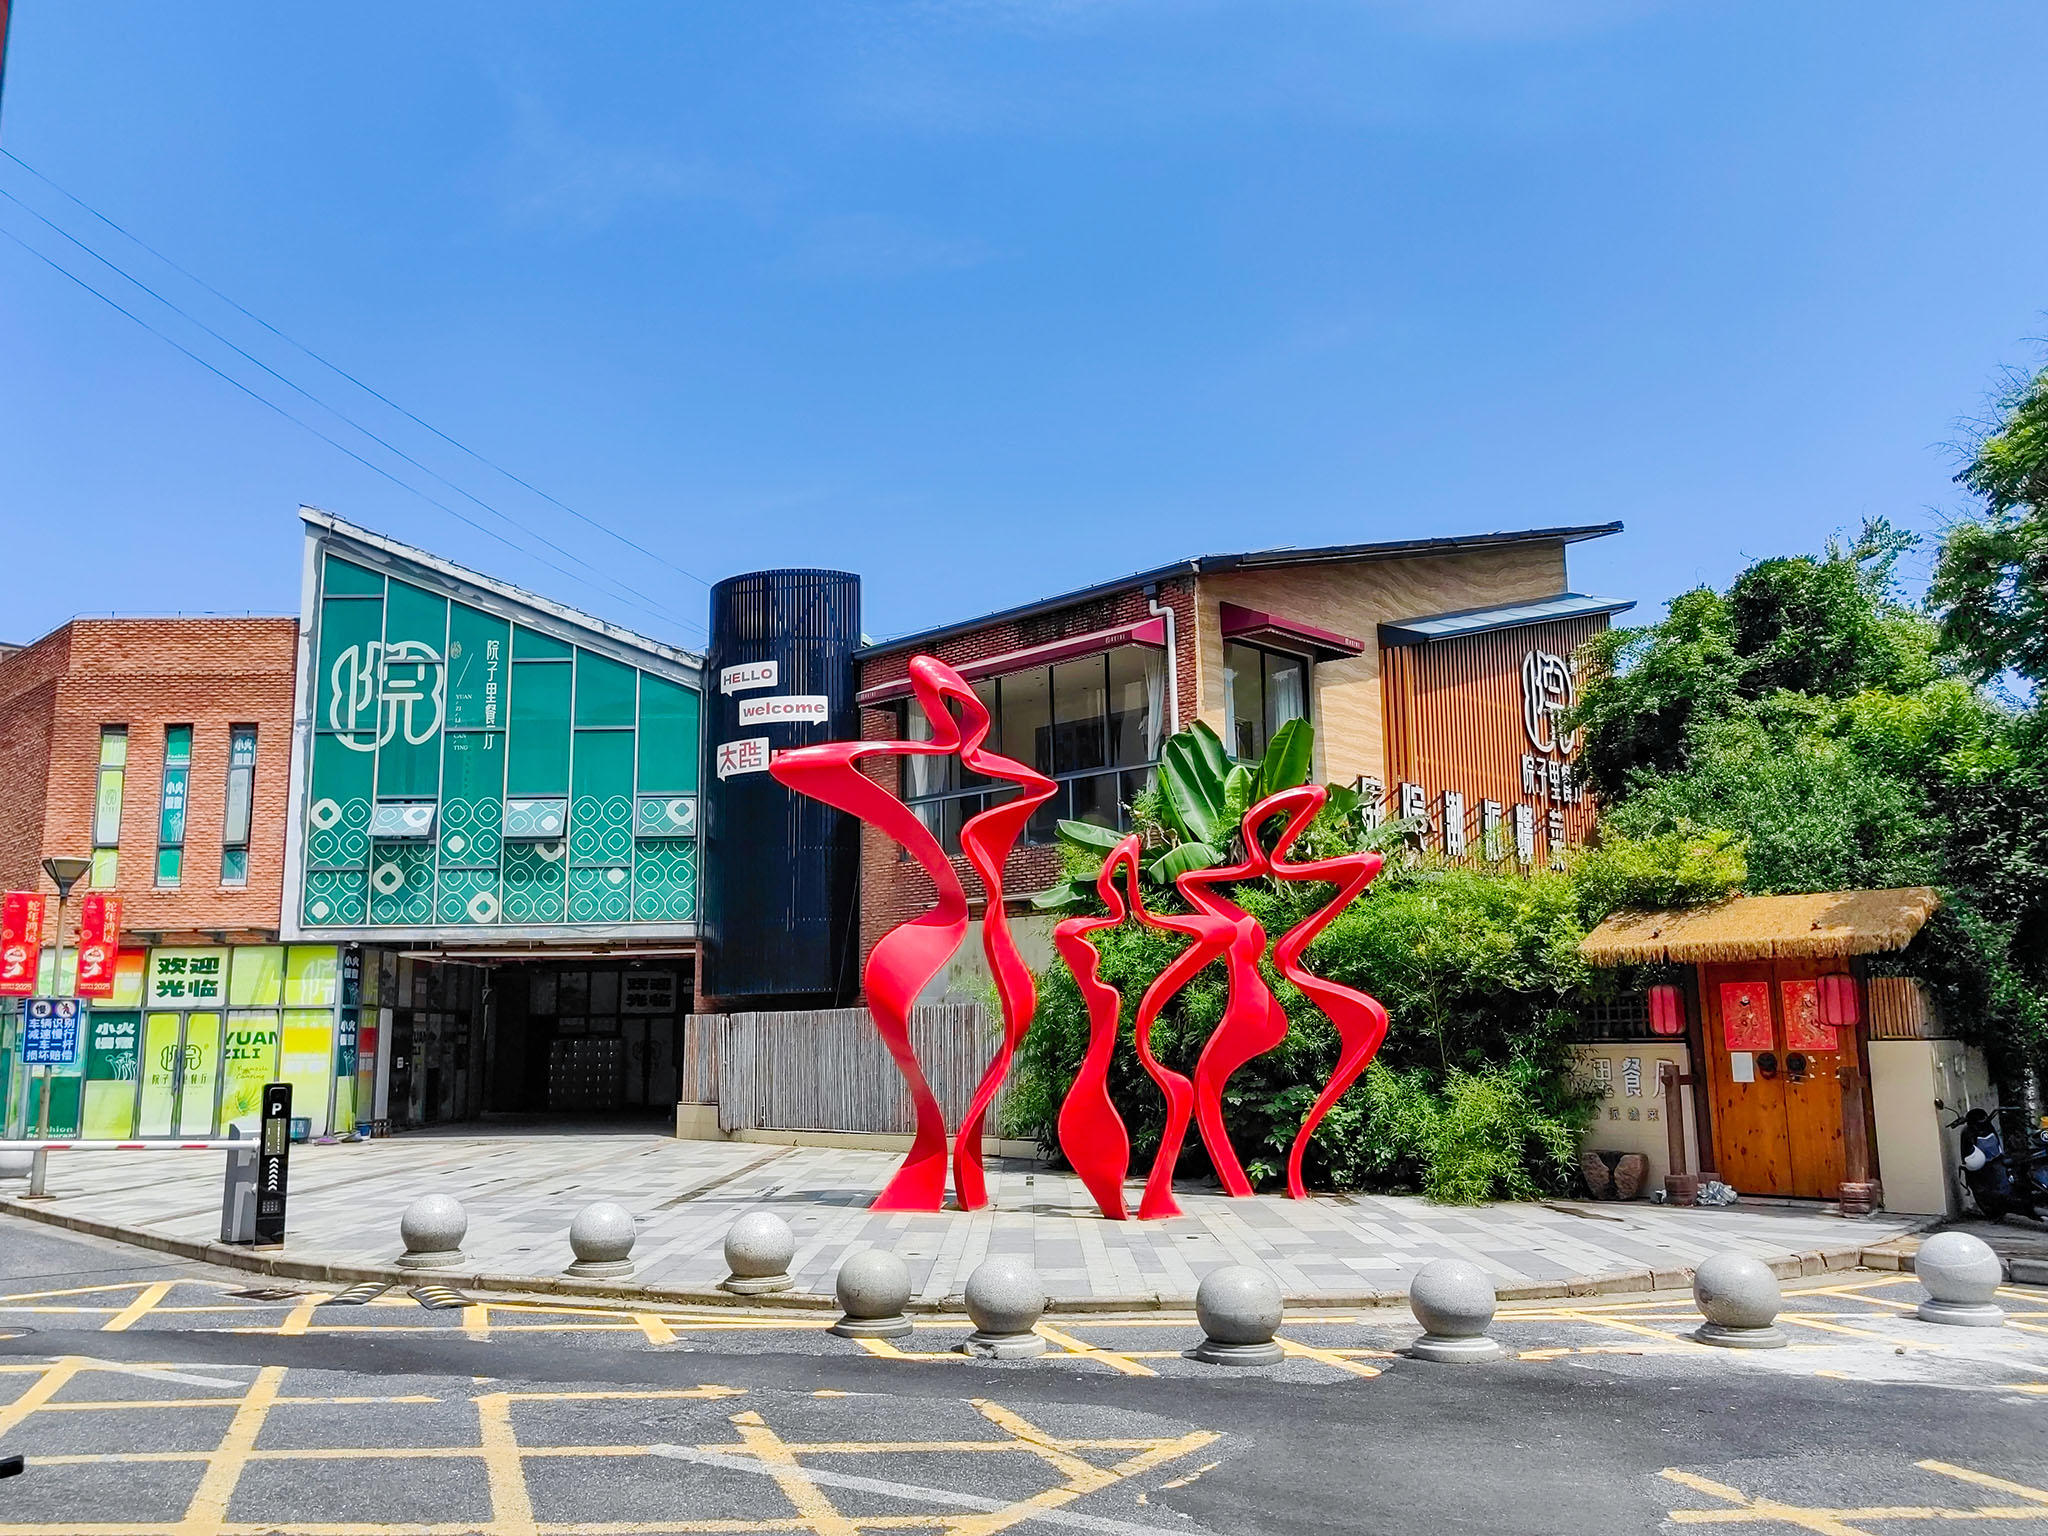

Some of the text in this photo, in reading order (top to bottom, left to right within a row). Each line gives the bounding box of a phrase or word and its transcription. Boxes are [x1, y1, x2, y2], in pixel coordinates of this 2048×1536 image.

[723, 668, 773, 686] HELLO
[743, 702, 825, 717] welcome
[24, 900, 41, 943] 蛇年鸿运
[102, 901, 118, 944] 蛇年鸿运
[157, 957, 220, 975] 欢迎
[156, 980, 219, 998] 光临
[29, 1018, 75, 1029] 车辆识别
[95, 1022, 136, 1036] 小火
[28, 1029, 75, 1039] 减速慢行
[27, 1040, 74, 1050] 一车一杆
[26, 1050, 73, 1061] 损坏赔偿
[272, 1103, 282, 1116] P
